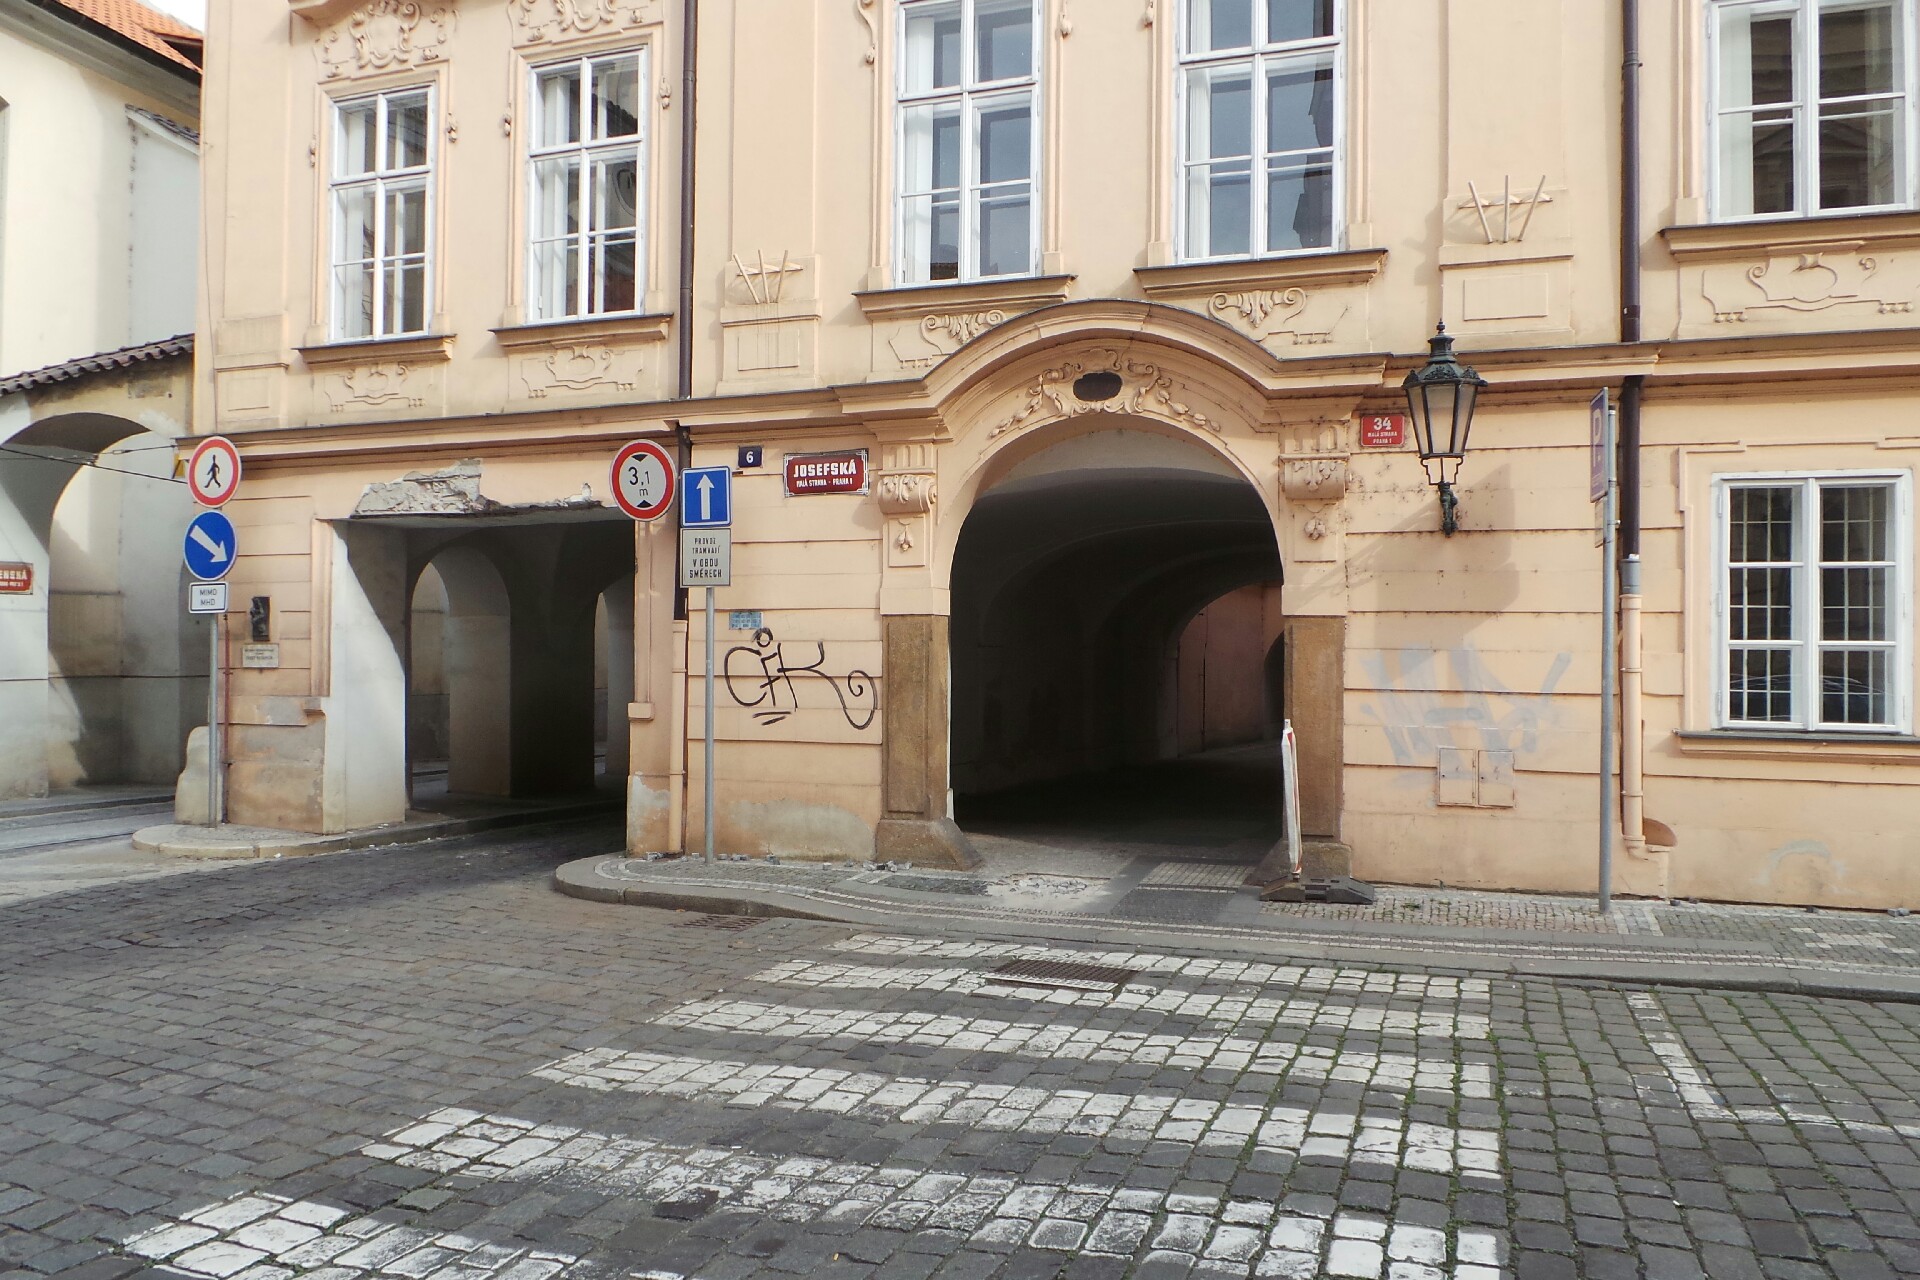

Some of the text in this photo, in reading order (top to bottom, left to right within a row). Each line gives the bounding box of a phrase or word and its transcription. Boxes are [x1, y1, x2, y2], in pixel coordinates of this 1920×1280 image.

[1373, 417, 1392, 430] 34
[746, 451, 754, 463] 6
[793, 459, 857, 478] JOSEFSKÁ
[628, 466, 650, 485] 3,1
[832, 478, 849, 486] PRAHA
[639, 488, 648, 496] m
[694, 537, 716, 545] PROVOZ
[692, 545, 720, 554] TRAMVAJÍ
[692, 558, 719, 567] V OBDU
[200, 588, 217, 596] MIMO
